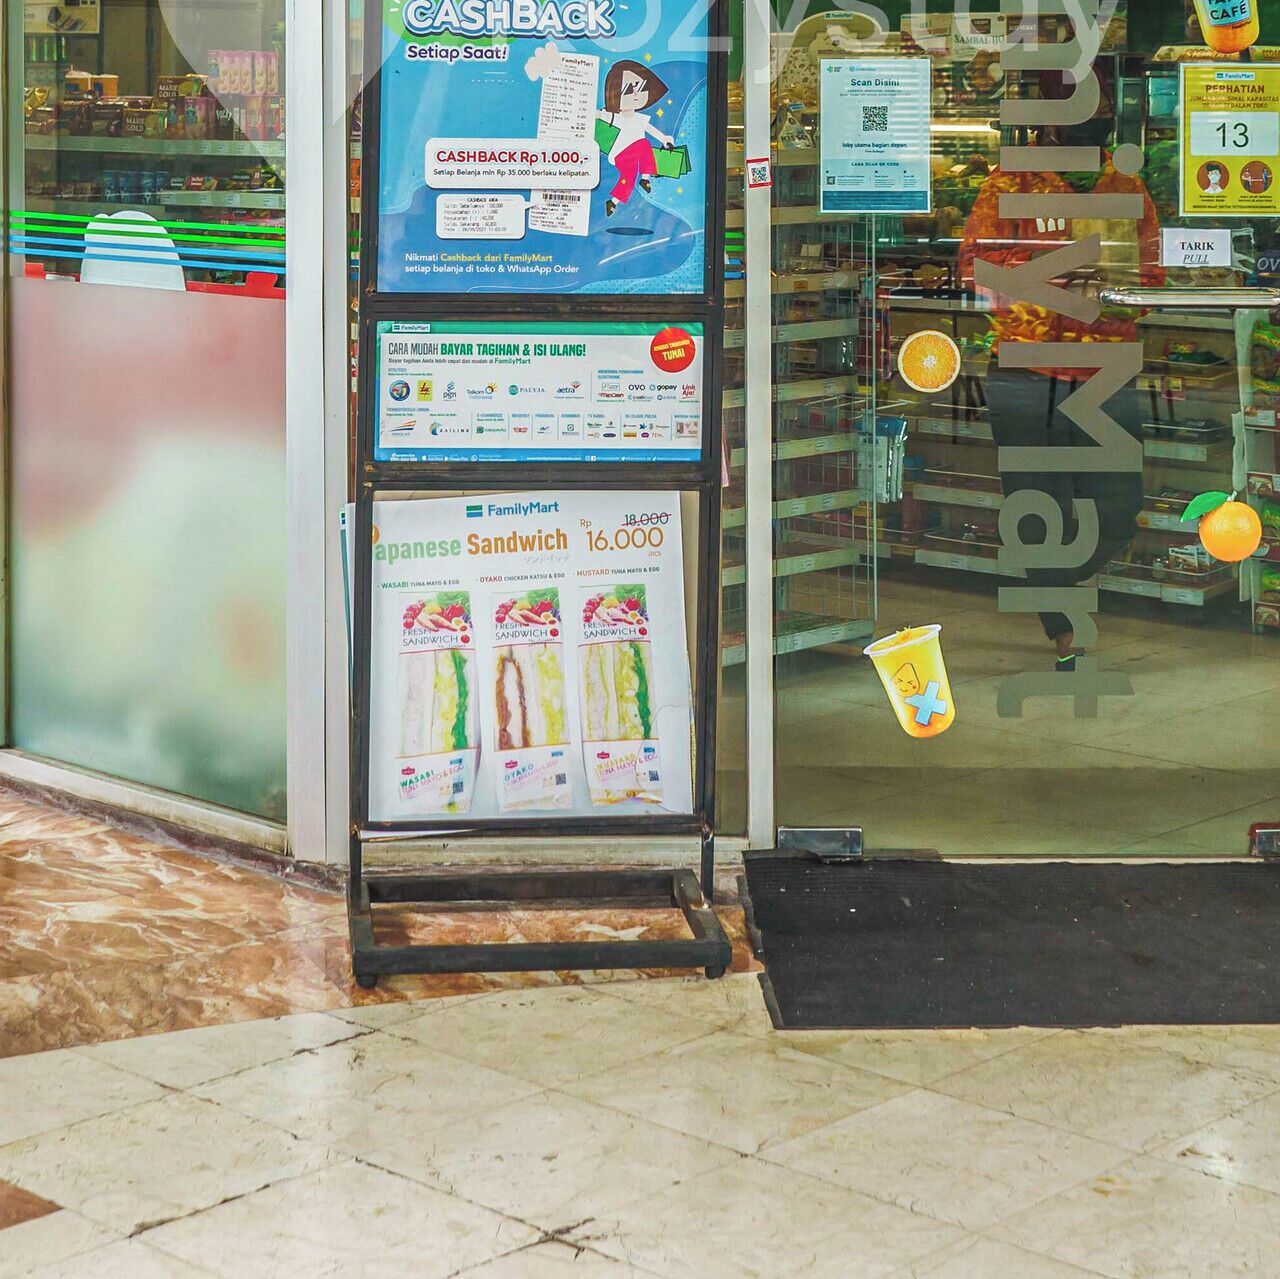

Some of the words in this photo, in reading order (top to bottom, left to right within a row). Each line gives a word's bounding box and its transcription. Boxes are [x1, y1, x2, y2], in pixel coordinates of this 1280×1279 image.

[1210, 2, 1246, 20] CAFÉ
[408, 45, 459, 62] Setiap
[463, 45, 507, 60] Saat!
[851, 78, 872, 86] Scan
[875, 78, 900, 86] Disini
[1206, 85, 1264, 93] PERHATIAN
[1216, 122, 1249, 148] 13
[436, 151, 517, 163] CASHBACK
[520, 152, 538, 166] Rp
[541, 152, 588, 164] 1.000,-
[1179, 241, 1214, 251] TARIK
[405, 253, 438, 262] Nikmati
[440, 253, 482, 262] Cashback
[484, 253, 501, 262] dari
[504, 254, 553, 264] FamilyMart
[1183, 253, 1210, 264] PULL
[405, 264, 431, 275] setiap
[433, 264, 464, 275] belanja
[466, 265, 475, 273] di
[476, 265, 496, 273] toko
[498, 265, 505, 273] &
[507, 265, 552, 275] WhatsApp
[554, 265, 579, 274] Order
[388, 343, 408, 355] CARA
[410, 343, 438, 355] MUDAH
[441, 344, 473, 355] BAYAR
[477, 344, 519, 356] TAGIHAN
[523, 344, 530, 356] &
[534, 344, 546, 356] ISI
[550, 344, 586, 356] ULANG!
[662, 350, 685, 361] TUNAI
[488, 502, 559, 516] FamilyMart
[580, 519, 592, 529] Rp
[624, 512, 669, 526] 18.000
[586, 527, 664, 552] 16.000
[372, 539, 461, 564] apanese
[467, 528, 568, 555] Sandwich
[504, 574, 528, 582] CHICKEN
[495, 628, 548, 640] SANDWICH
[583, 627, 639, 639] SANDWICH
[402, 635, 458, 646] SANDWICH
